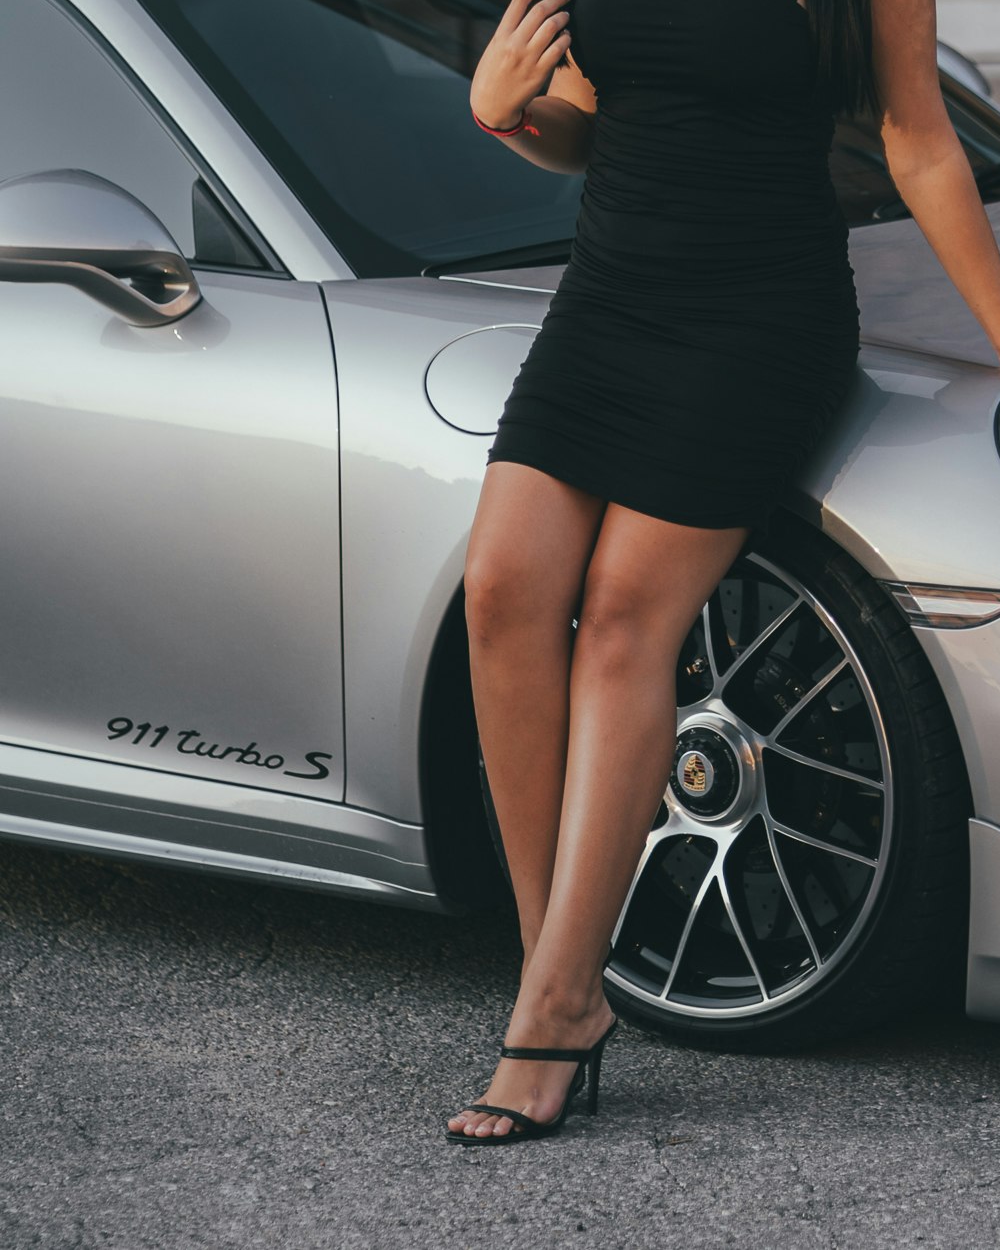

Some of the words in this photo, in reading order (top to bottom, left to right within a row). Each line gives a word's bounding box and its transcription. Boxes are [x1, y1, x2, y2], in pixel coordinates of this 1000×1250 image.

[106, 716, 170, 748] 911
[176, 729, 285, 769] turbo
[282, 750, 334, 781] S
